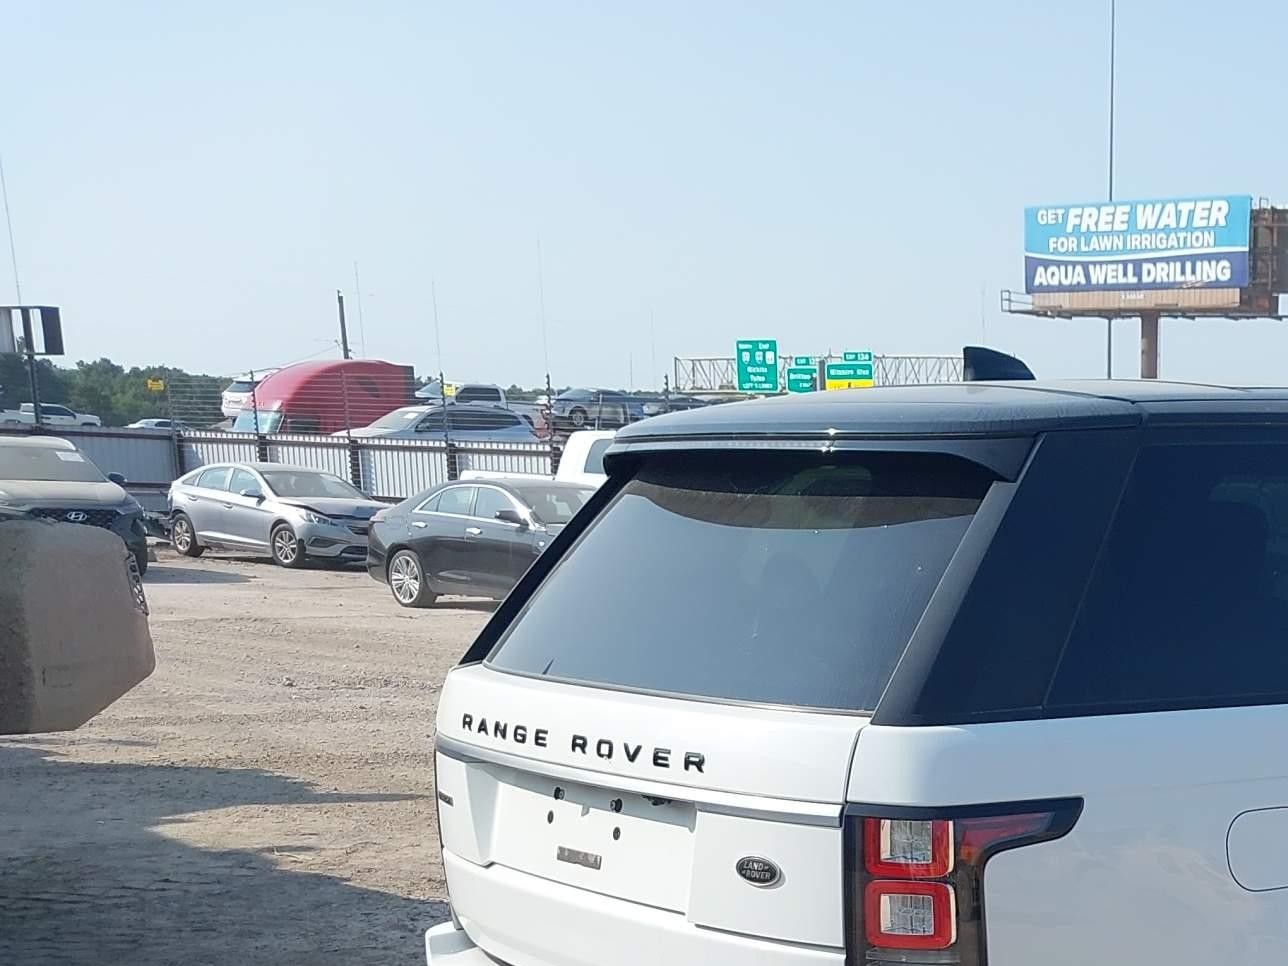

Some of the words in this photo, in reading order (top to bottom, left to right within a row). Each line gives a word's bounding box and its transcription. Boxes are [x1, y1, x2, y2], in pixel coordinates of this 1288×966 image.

[1038, 210, 1065, 225] GET
[1065, 204, 1130, 233] FREE
[1136, 200, 1229, 230] WATER
[1049, 238, 1078, 253] FOR
[1081, 235, 1123, 252] LAWN
[1127, 231, 1214, 250] IRRIGATION
[1034, 265, 1086, 286] AQUA
[1089, 264, 1138, 285] WELL
[1142, 261, 1231, 284] DRILLING
[462, 712, 549, 748] RANGE
[571, 734, 707, 774] ROVER
